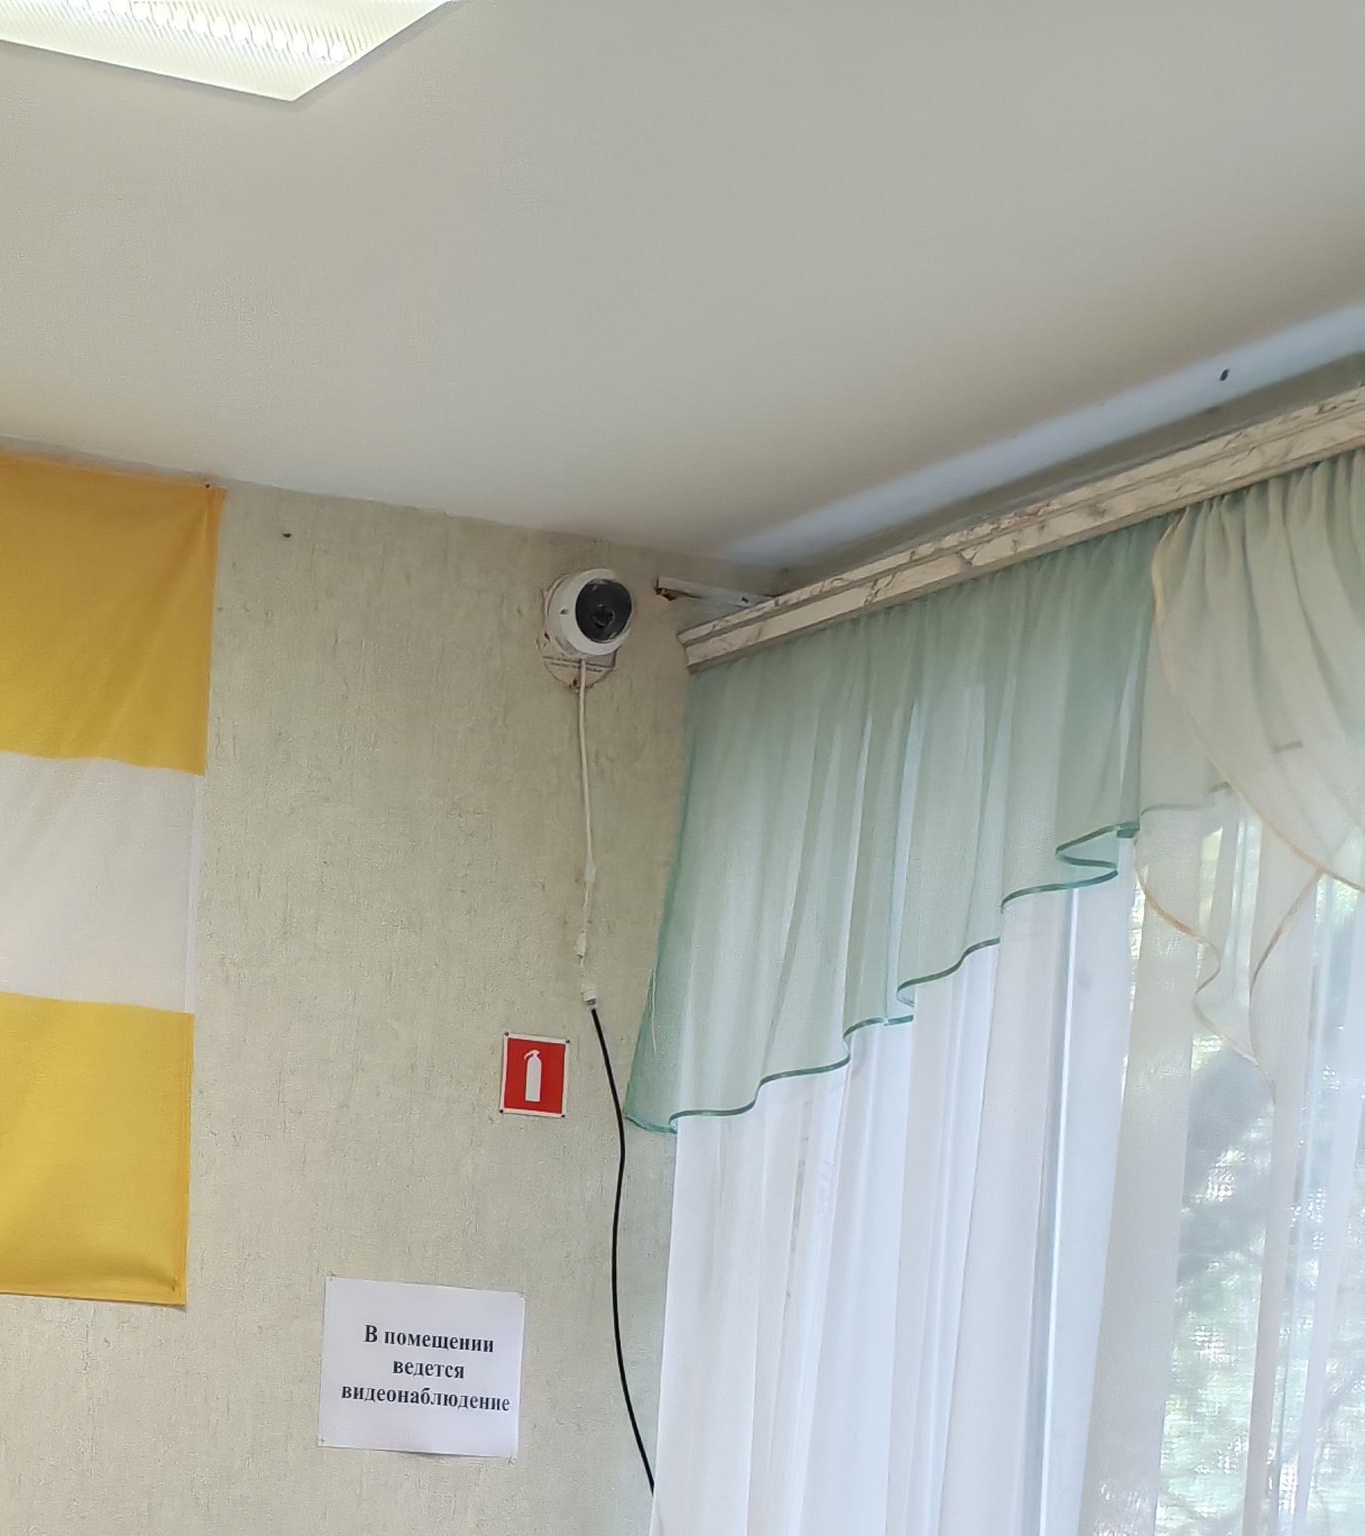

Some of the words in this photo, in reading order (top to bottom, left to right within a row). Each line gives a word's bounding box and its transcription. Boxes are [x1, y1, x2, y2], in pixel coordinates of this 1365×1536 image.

[363, 1324, 378, 1343] В
[384, 1330, 494, 1353] помещении
[392, 1360, 465, 1379] ведется
[341, 1385, 511, 1412] видеонаблюдение
